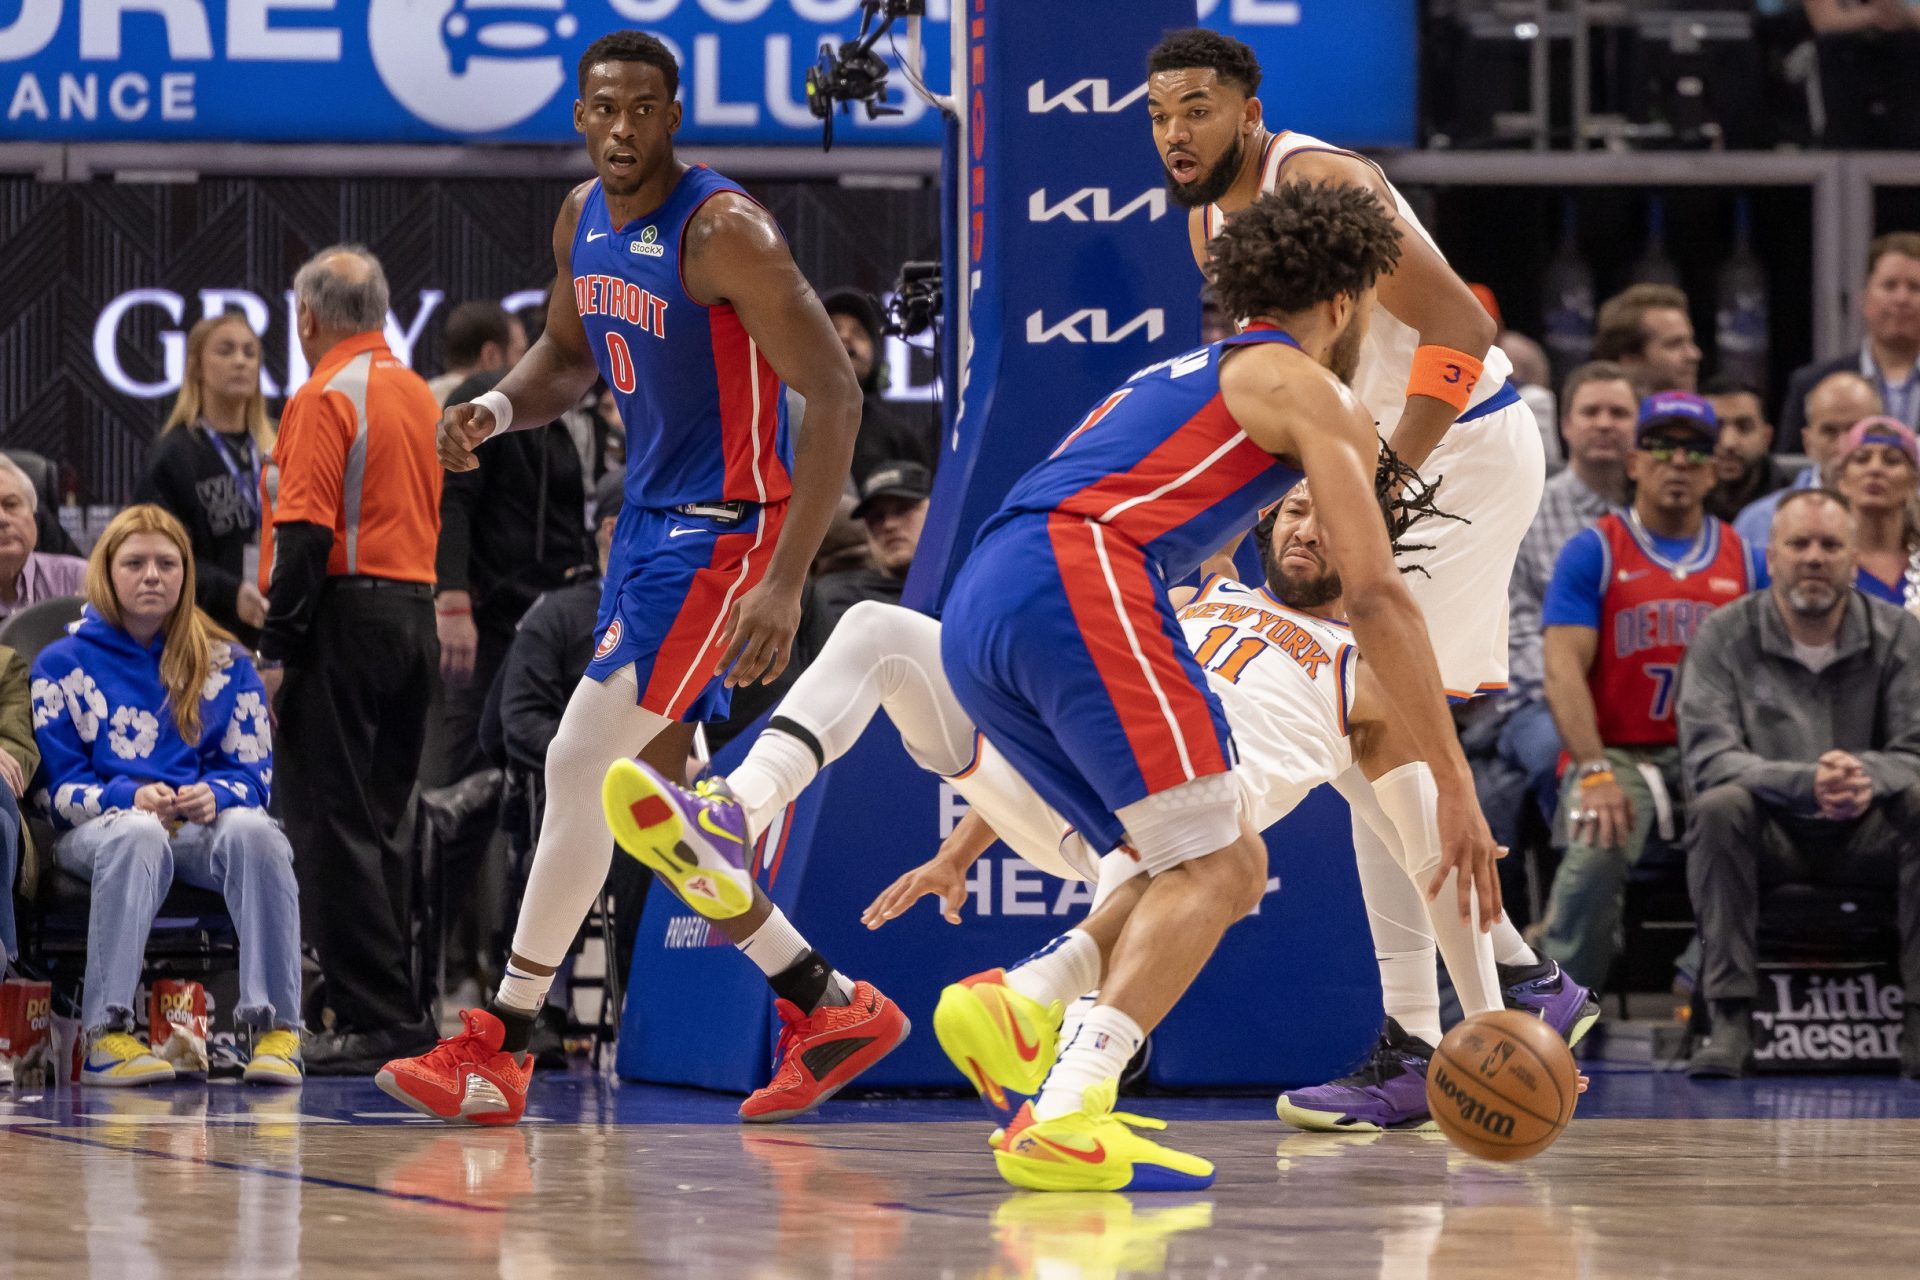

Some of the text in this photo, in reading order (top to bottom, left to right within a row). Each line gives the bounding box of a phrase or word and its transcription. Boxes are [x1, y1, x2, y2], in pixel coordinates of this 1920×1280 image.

[7, 72, 197, 121] ANCE
[631, 242, 663, 256] StockX
[573, 274, 669, 340] DETROIT
[605, 331, 637, 395] 0
[1192, 623, 1271, 686] 11
[1249, 610, 1332, 681] YORK
[1768, 973, 1905, 1021] Little
